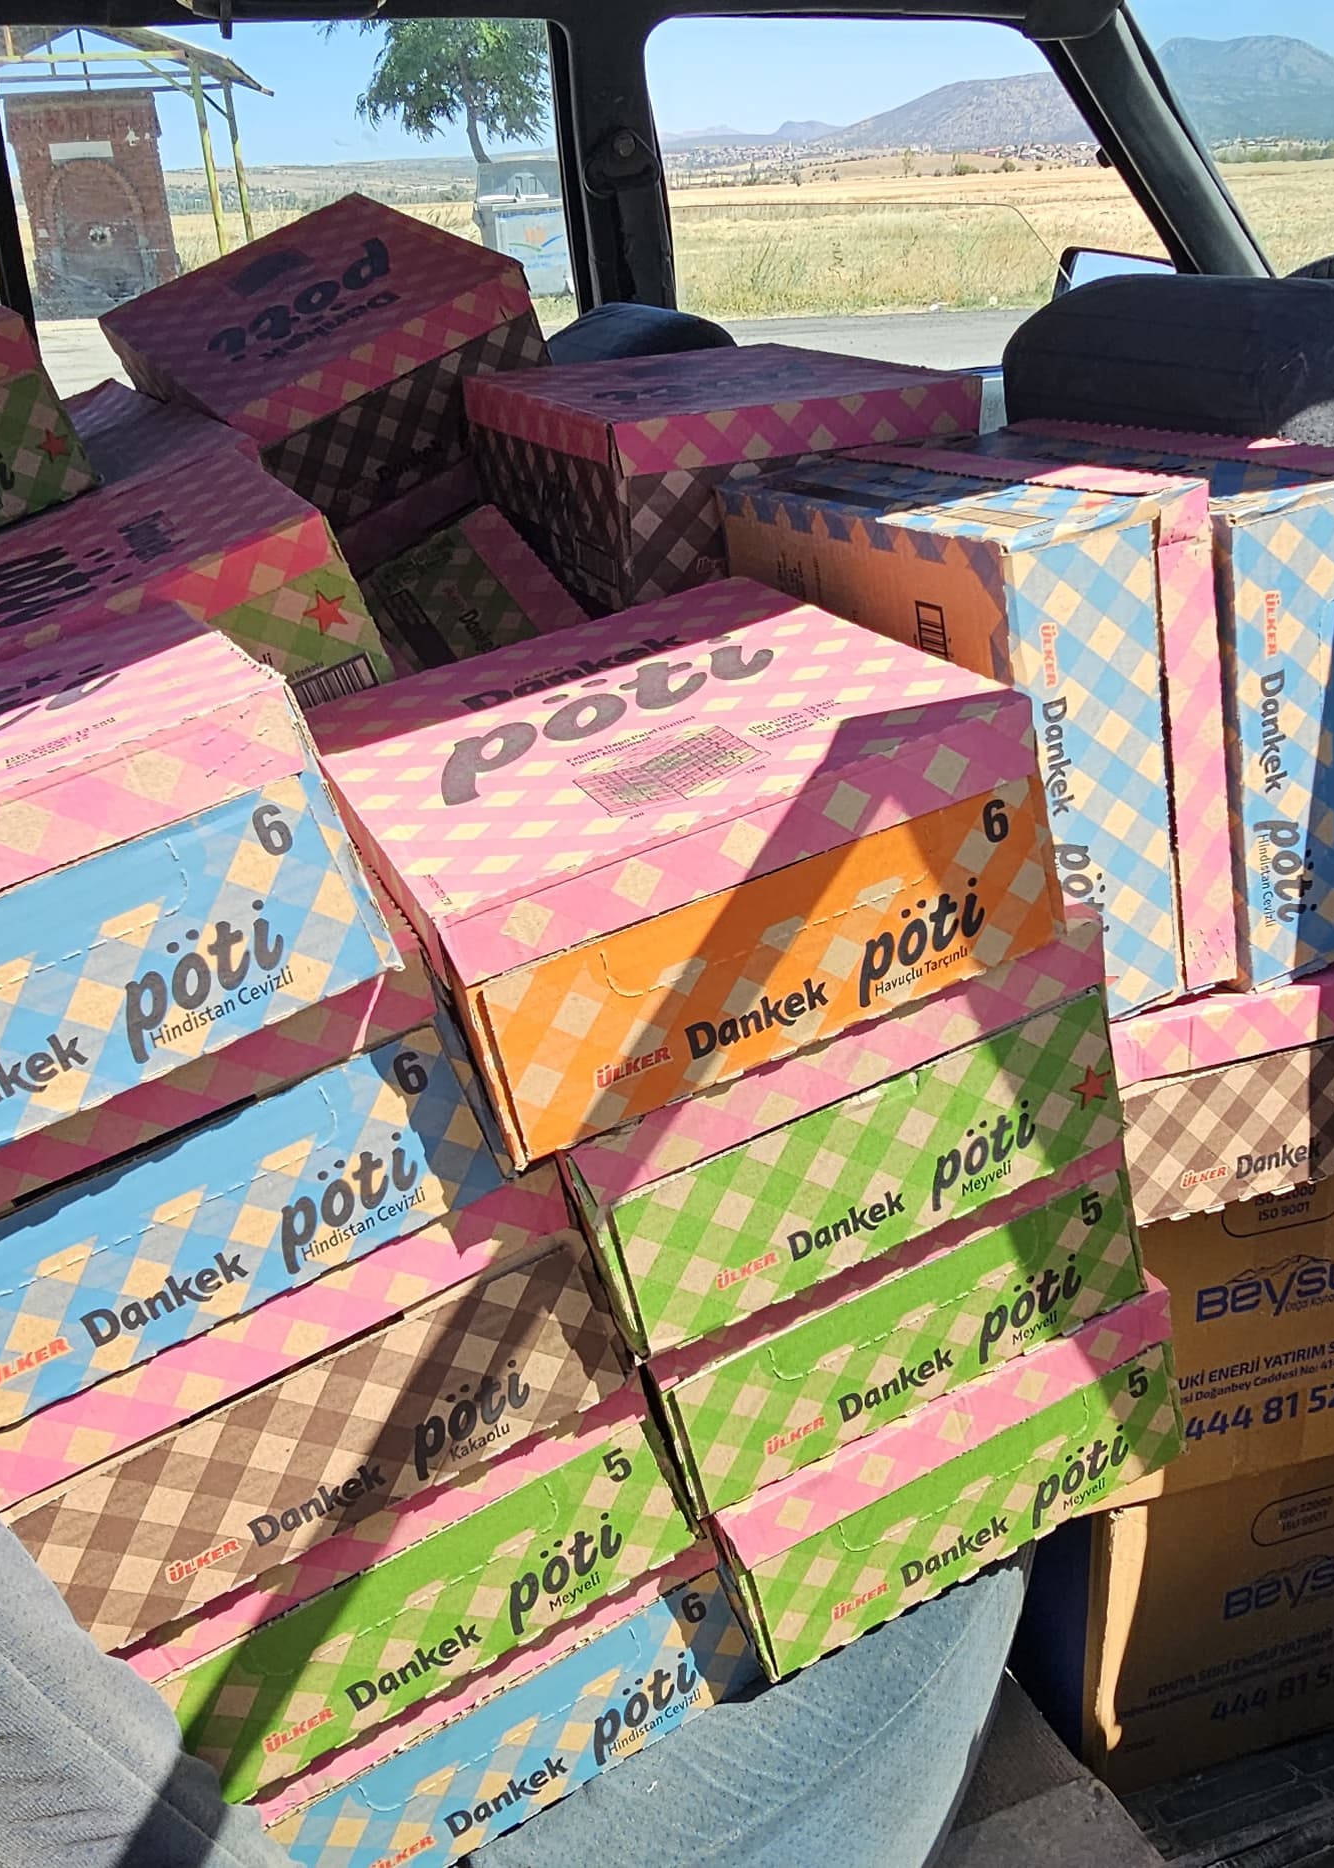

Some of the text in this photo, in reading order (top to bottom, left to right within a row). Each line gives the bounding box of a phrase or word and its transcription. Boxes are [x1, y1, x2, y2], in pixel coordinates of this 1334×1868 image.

[207, 237, 391, 362] pöti
[461, 633, 687, 711] Dankek
[1039, 622, 1058, 688] ÜLKER
[440, 636, 774, 806] pöti
[1039, 695, 1072, 818] Dankek
[1252, 590, 1317, 923] ÜLKER Dankek pöti
[251, 803, 294, 856] 6
[982, 799, 1010, 843] 6
[125, 900, 284, 1064] pöti
[596, 877, 986, 1089] ÜLKER Dankek pöti
[874, 945, 969, 998] Havuçlu Tarçınlı
[150, 965, 295, 1049] Hindistan Cevizli
[393, 1050, 429, 1096] 6
[961, 1159, 1013, 1197] Meyveli
[1181, 1166, 1228, 1188] ÜLKER
[1235, 1136, 1321, 1180] Dankek
[717, 1099, 1037, 1290] ÜLKER Dankek pöti
[1080, 1190, 1103, 1226] 5
[1259, 1207, 1279, 1221] ISO
[78, 1252, 249, 1349] Dankek
[280, 1131, 418, 1274] pöti
[301, 1186, 427, 1263] Hindistan Cevizli
[764, 1253, 1083, 1455] ÜLKER Dankek pöti
[1011, 1312, 1059, 1346] Meyveli
[1128, 1367, 1149, 1400] 5
[1208, 1355, 1260, 1382] ENERJİ
[1263, 1343, 1326, 1370] YATIRIM
[449, 1422, 512, 1464] Kakaolu
[1185, 1404, 1254, 1441] 444
[1262, 1391, 1300, 1425] 81
[167, 1358, 531, 1584] ÜLKER Dankek pöti
[601, 1447, 634, 1484] 5
[1062, 1476, 1107, 1512] Meyveli
[833, 1424, 1130, 1621] ÜLKER Dankek pöti
[548, 1572, 601, 1613] Meyveli
[681, 1592, 707, 1624] 6
[264, 1512, 623, 1756] ÜLKER Dankek pöti
[607, 1689, 702, 1757] Hindistan Cevizli
[1210, 1686, 1269, 1722] 444
[1277, 1673, 1310, 1703] 81
[443, 1757, 568, 1839] Dankek
[593, 1652, 698, 1766] pöti
